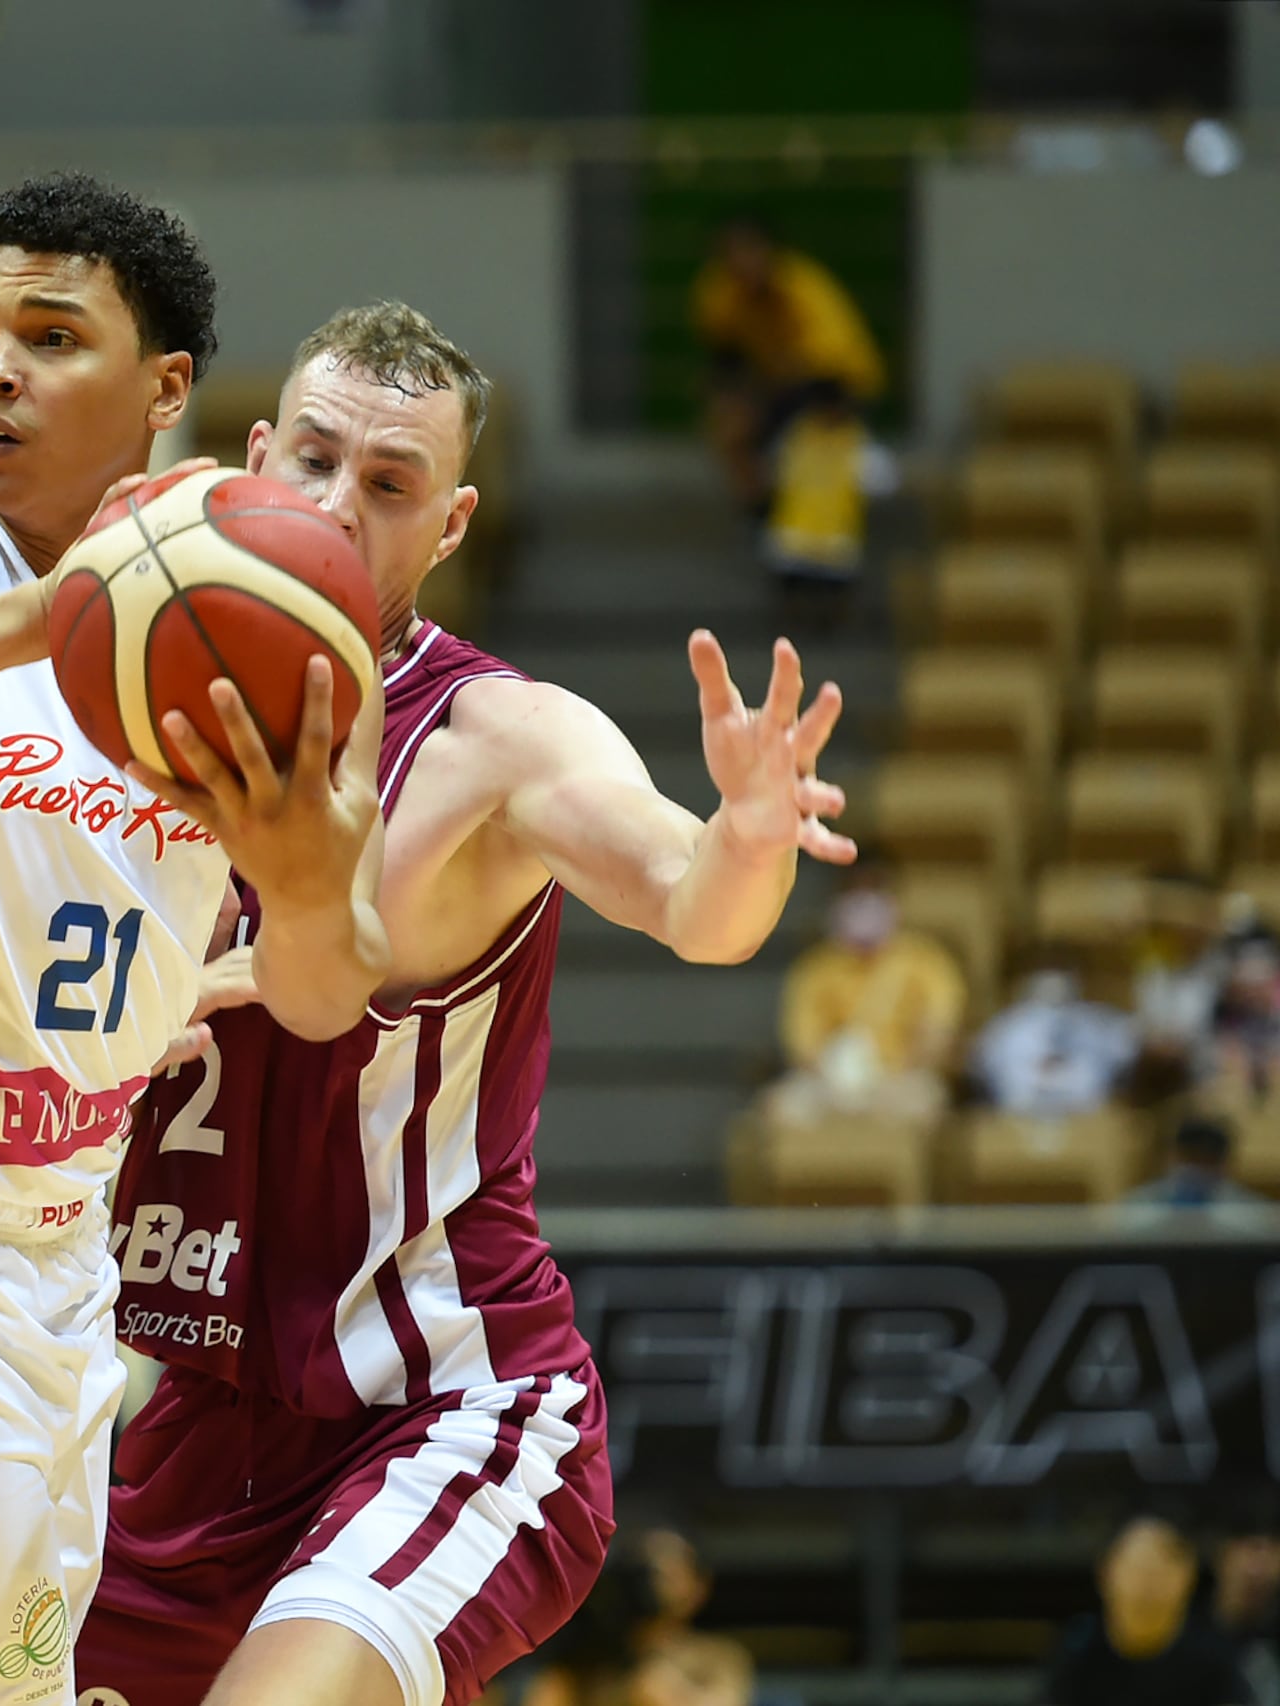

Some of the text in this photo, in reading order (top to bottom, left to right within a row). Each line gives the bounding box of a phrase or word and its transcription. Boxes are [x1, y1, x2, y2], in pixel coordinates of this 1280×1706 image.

[35, 901, 144, 1034] 21
[153, 1038, 226, 1156] 2
[117, 1302, 244, 1349] Sports Ba
[572, 1263, 1218, 1487] FIBA
